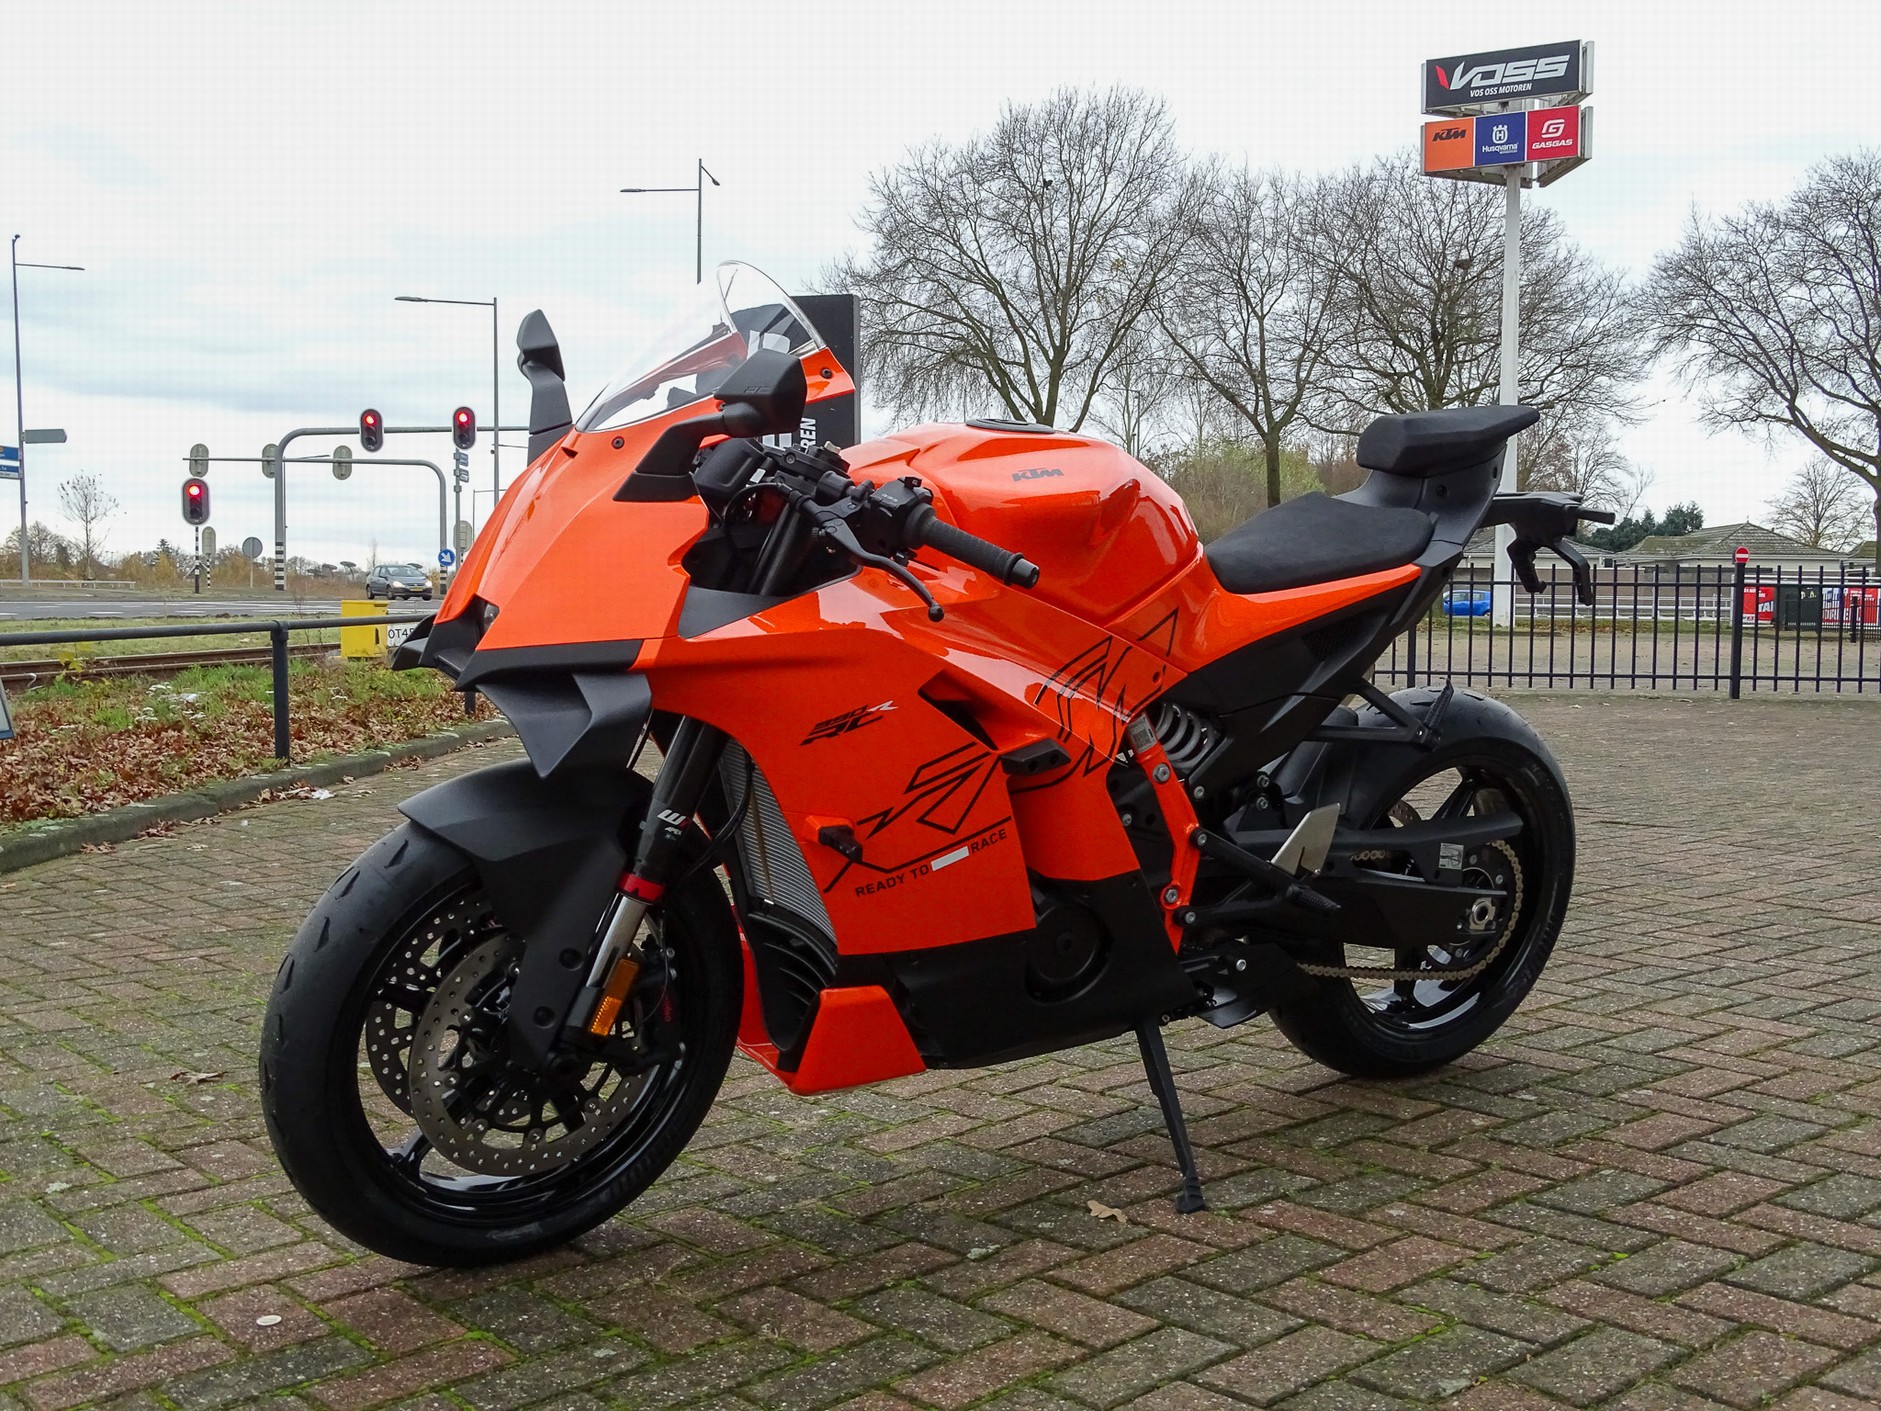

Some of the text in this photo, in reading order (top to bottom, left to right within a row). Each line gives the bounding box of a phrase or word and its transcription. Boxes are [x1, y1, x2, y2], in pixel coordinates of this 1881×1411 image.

[1436, 54, 1571, 91] VOSS
[1470, 82, 1533, 98] VOS OSS MOTOREN
[1432, 127, 1467, 142] KTM
[1482, 143, 1519, 154] Husqvarna
[1532, 138, 1573, 150] GASGAS
[1011, 467, 1064, 482] KTM
[855, 828, 1008, 897] READY TO RACE
